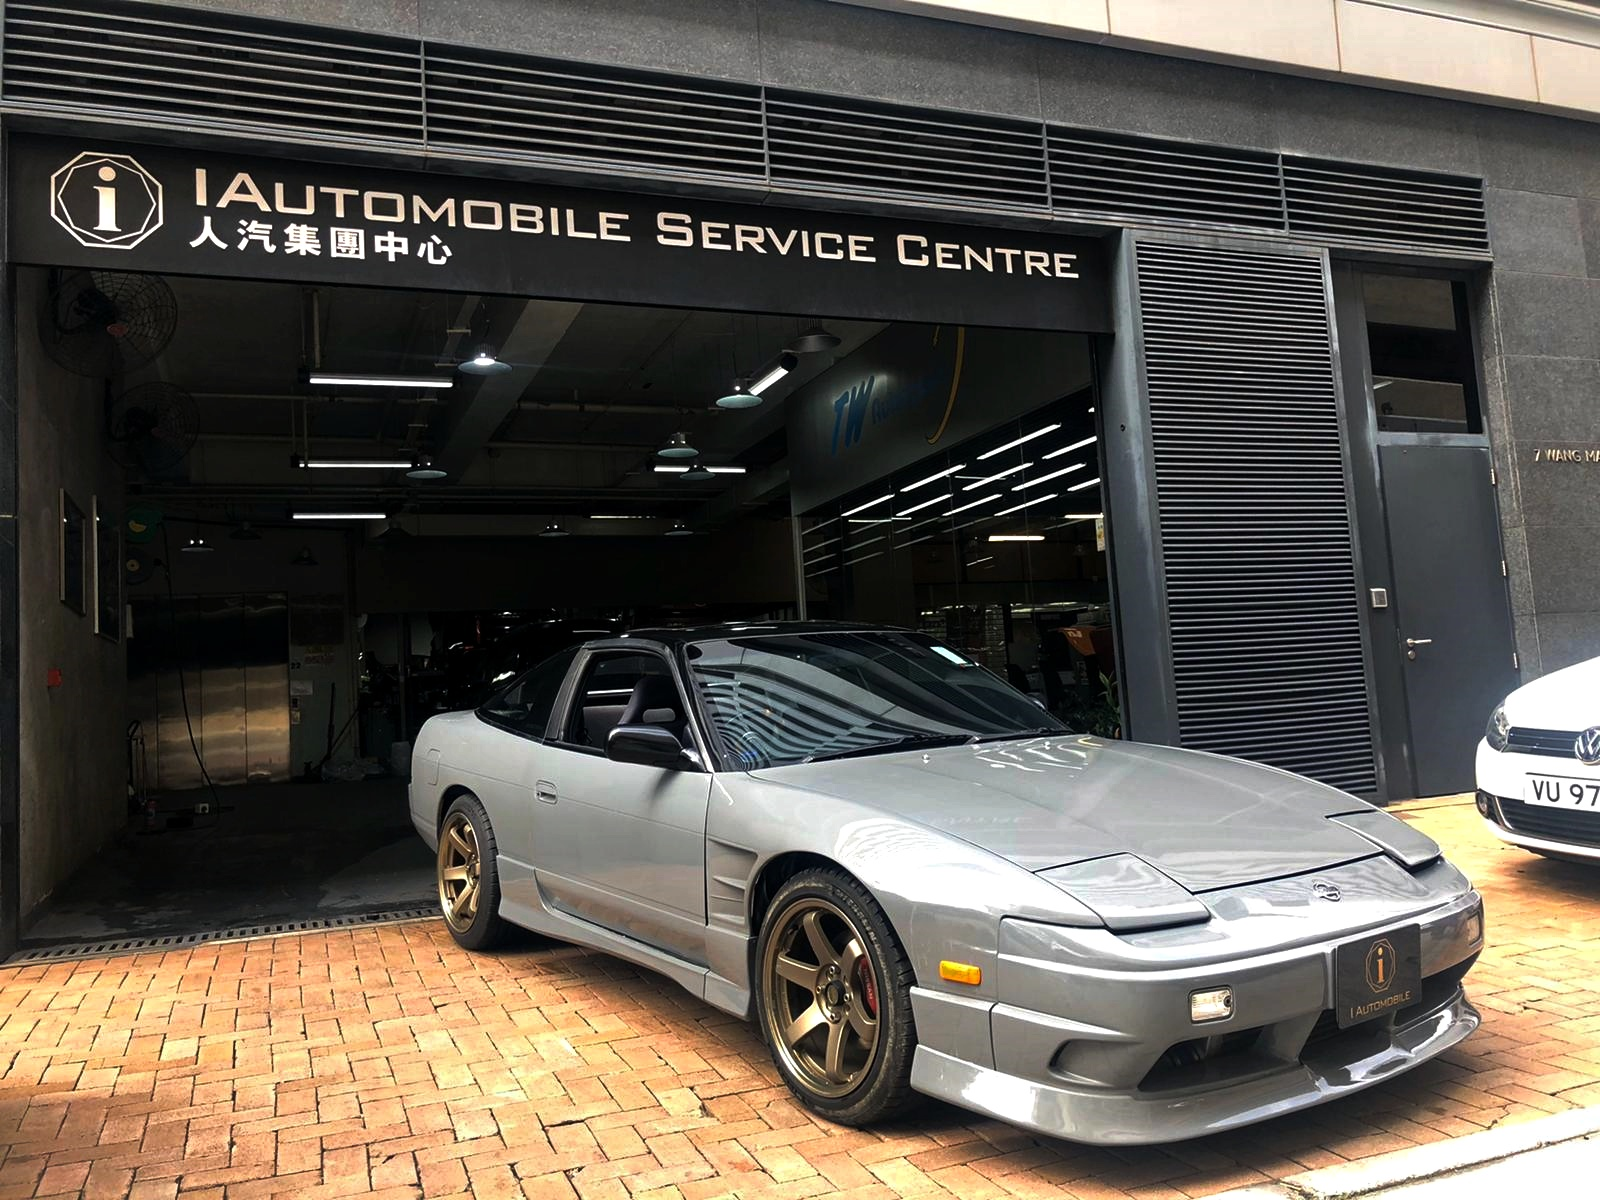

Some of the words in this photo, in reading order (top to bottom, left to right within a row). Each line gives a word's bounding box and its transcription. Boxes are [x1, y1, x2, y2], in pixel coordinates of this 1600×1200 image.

[189, 216, 453, 265] 人汽集團中心
[656, 212, 876, 263] SERVICE
[896, 235, 1079, 279] CENTRE
[1534, 448, 1541, 462] 7
[1545, 449, 1581, 462] WANG
[1532, 780, 1560, 802] VU
[1569, 784, 1600, 806] 97
